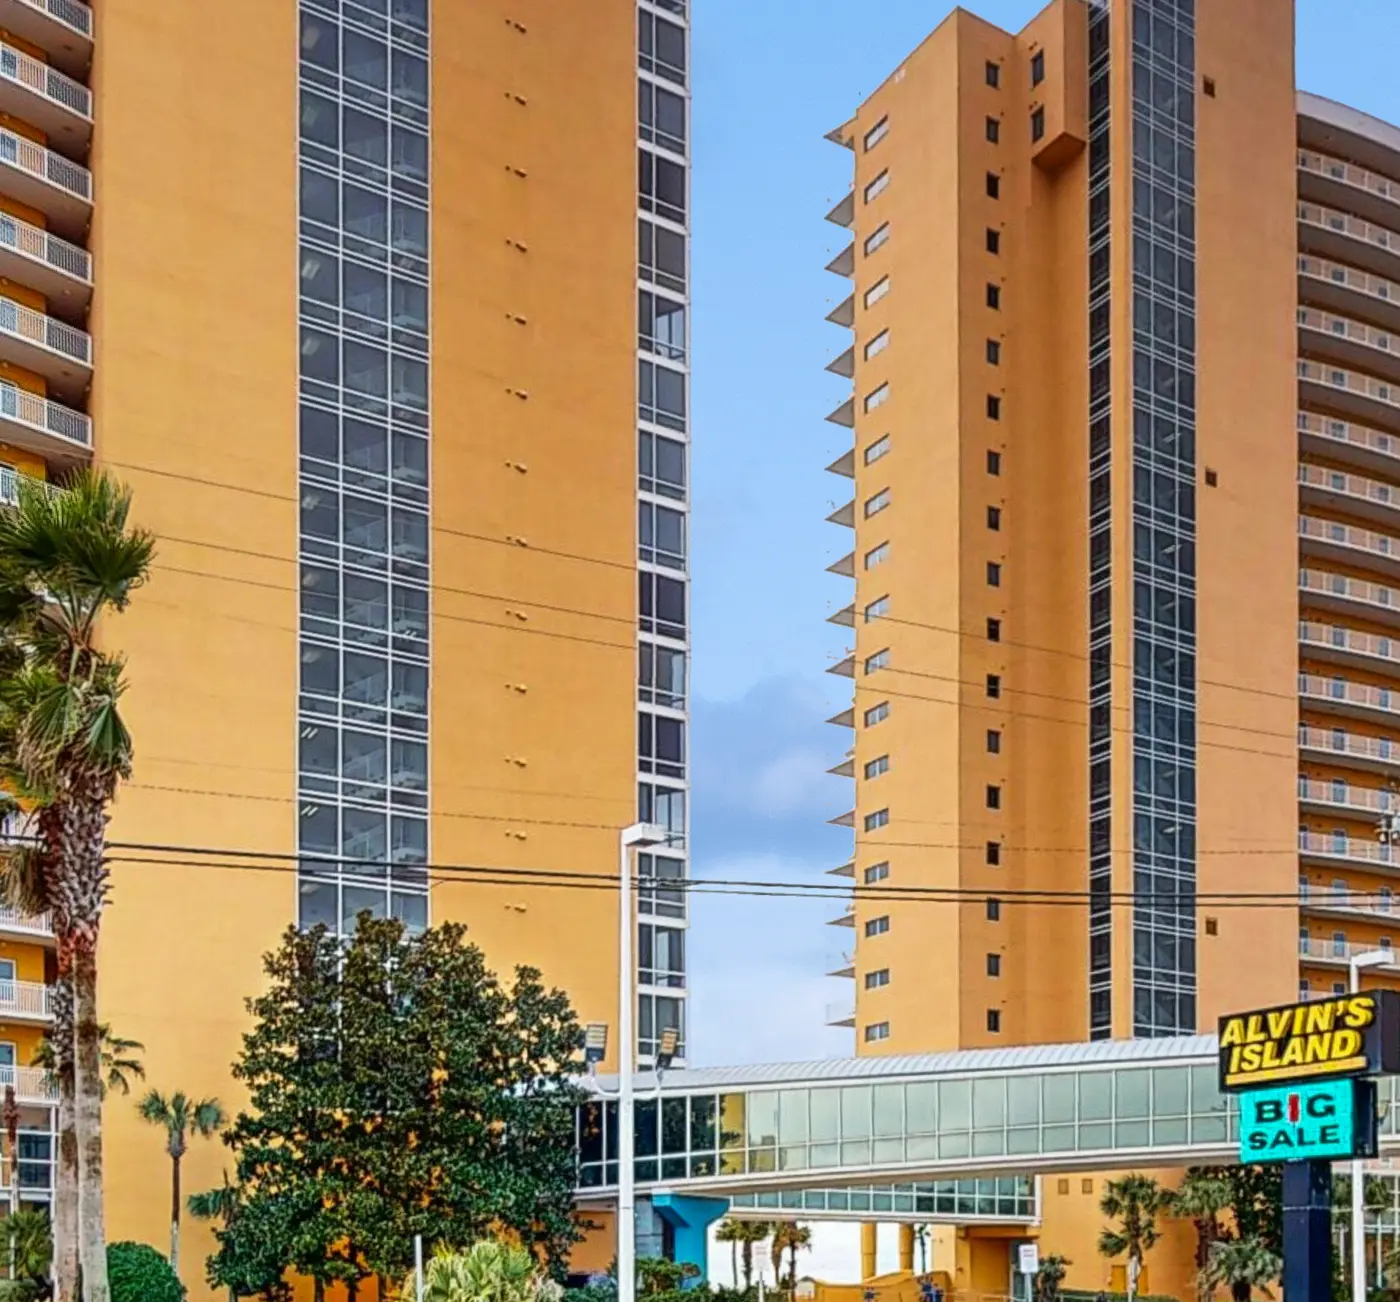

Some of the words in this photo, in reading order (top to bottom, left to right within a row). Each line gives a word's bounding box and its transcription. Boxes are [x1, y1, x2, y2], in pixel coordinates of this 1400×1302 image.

[1220, 997, 1375, 1047] ALVIN'S
[1229, 1029, 1362, 1073] ISLAND
[1255, 1093, 1336, 1123] BIG
[1248, 1124, 1341, 1150] SALE
